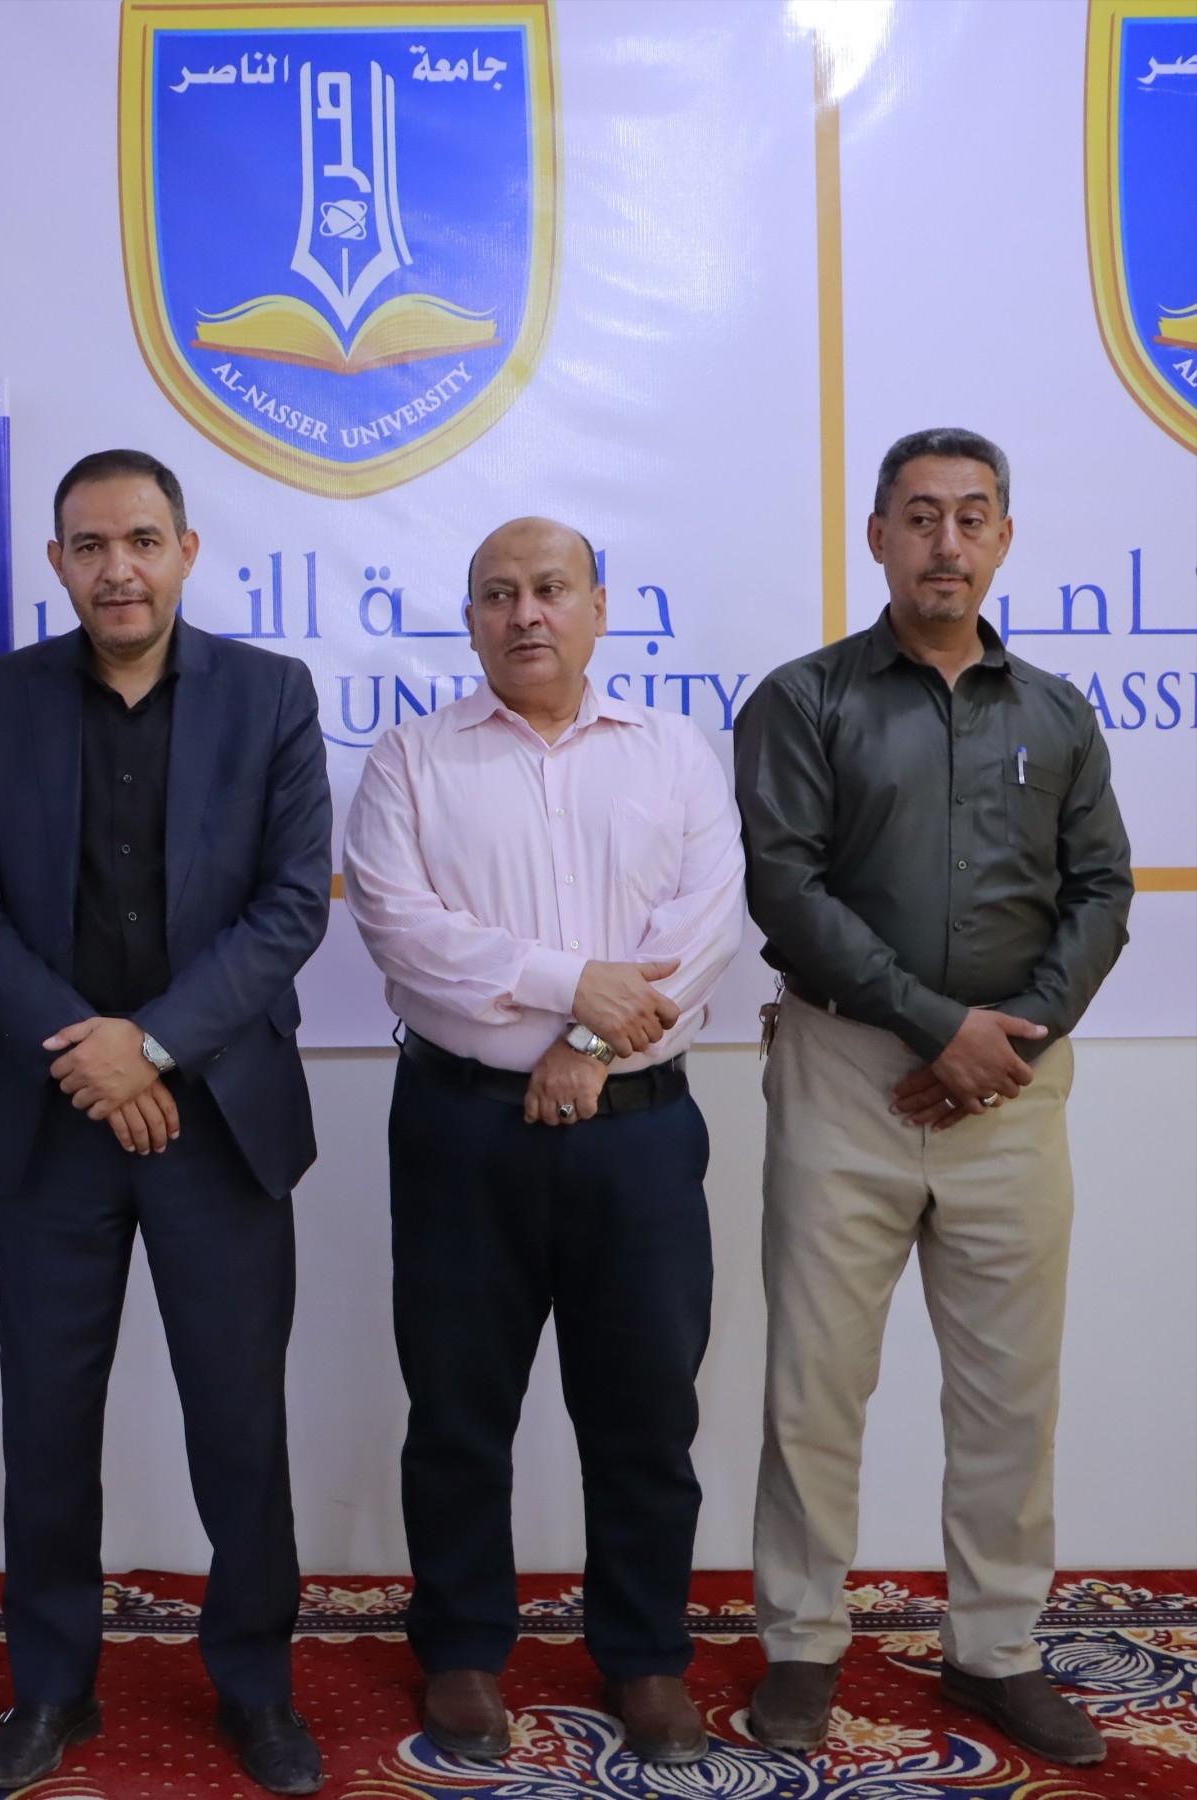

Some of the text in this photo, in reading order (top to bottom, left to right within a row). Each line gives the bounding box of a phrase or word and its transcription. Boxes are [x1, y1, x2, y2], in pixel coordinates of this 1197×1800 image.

[169, 45, 507, 93] جامعة الناصر
[211, 361, 473, 449] AL-NASSER UNIVERSITY
